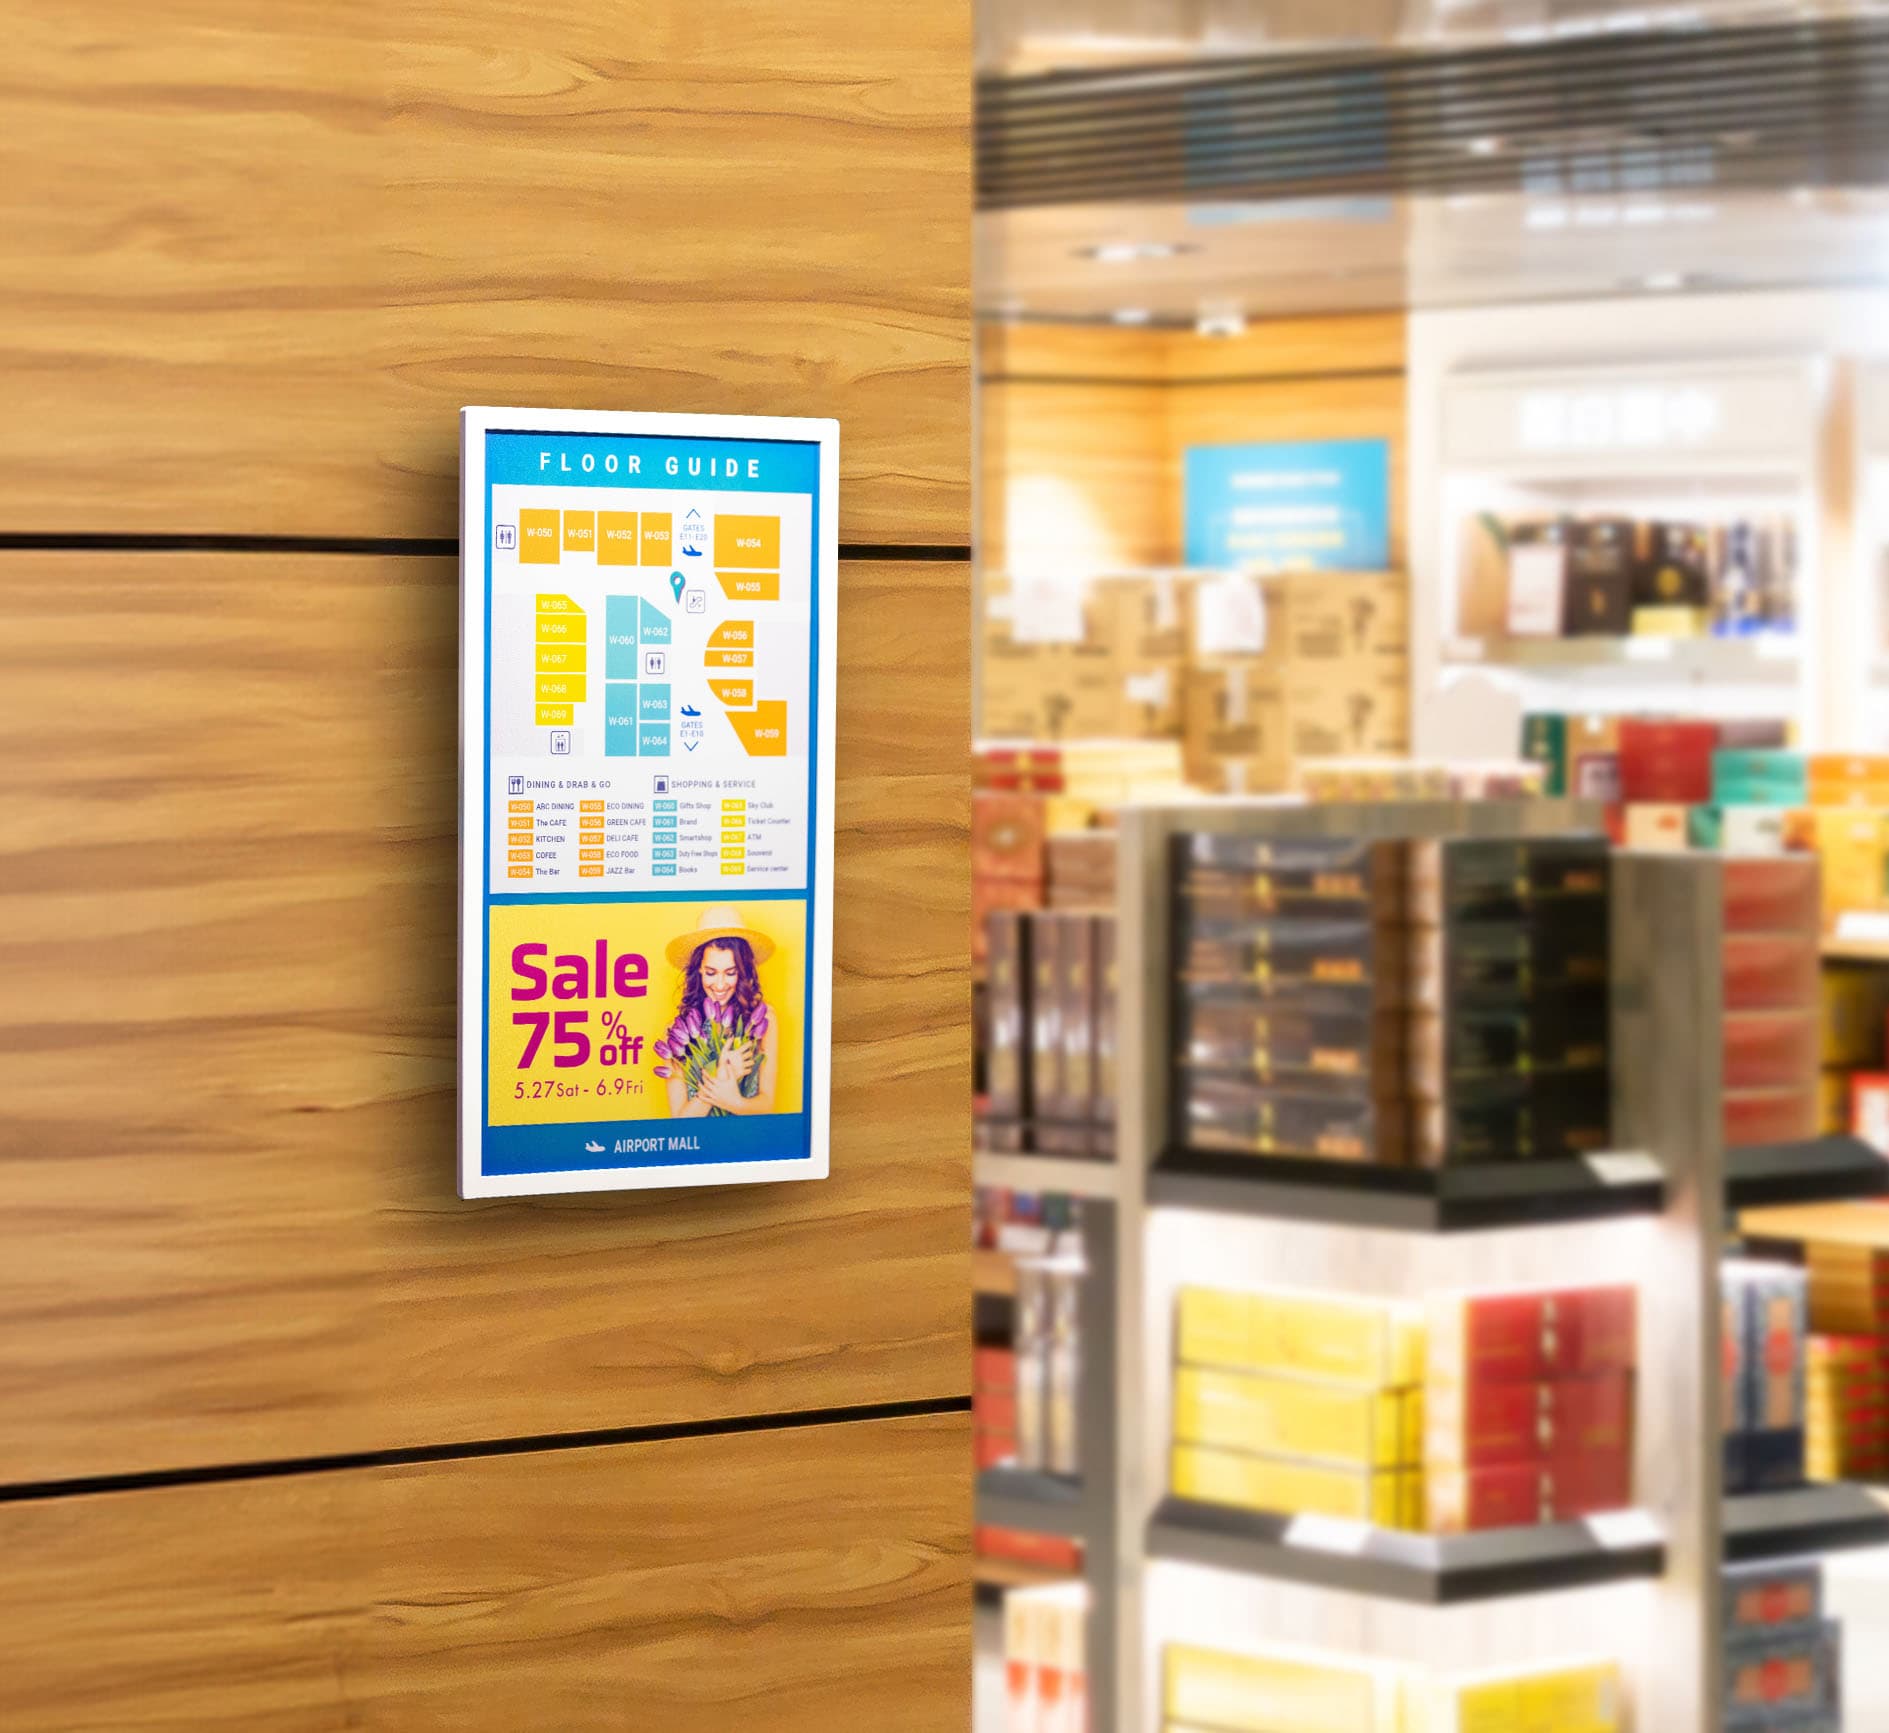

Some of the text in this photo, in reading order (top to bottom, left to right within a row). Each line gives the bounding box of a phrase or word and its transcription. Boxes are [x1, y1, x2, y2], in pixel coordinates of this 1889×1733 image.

[540, 452, 760, 478] FLOOR GUIDE
[526, 527, 553, 538] W-050
[567, 528, 592, 539] W-051
[606, 529, 632, 540] W-052
[644, 531, 670, 541] W-053
[736, 538, 761, 548] W-054
[736, 582, 761, 592] W-055
[643, 627, 668, 637] W-062
[609, 635, 635, 645] W-060
[642, 699, 668, 709] W-063
[608, 716, 633, 726] W-061
[642, 735, 667, 746] W-064
[526, 780, 611, 789] DINING & DRAB & GO
[671, 780, 713, 789] SHOPPING
[723, 780, 756, 788] SERVICE
[511, 939, 649, 1001] Sale
[512, 1010, 627, 1069] 75 %
[599, 1036, 643, 1066] off
[614, 1136, 701, 1153] AIRPORT MALL
